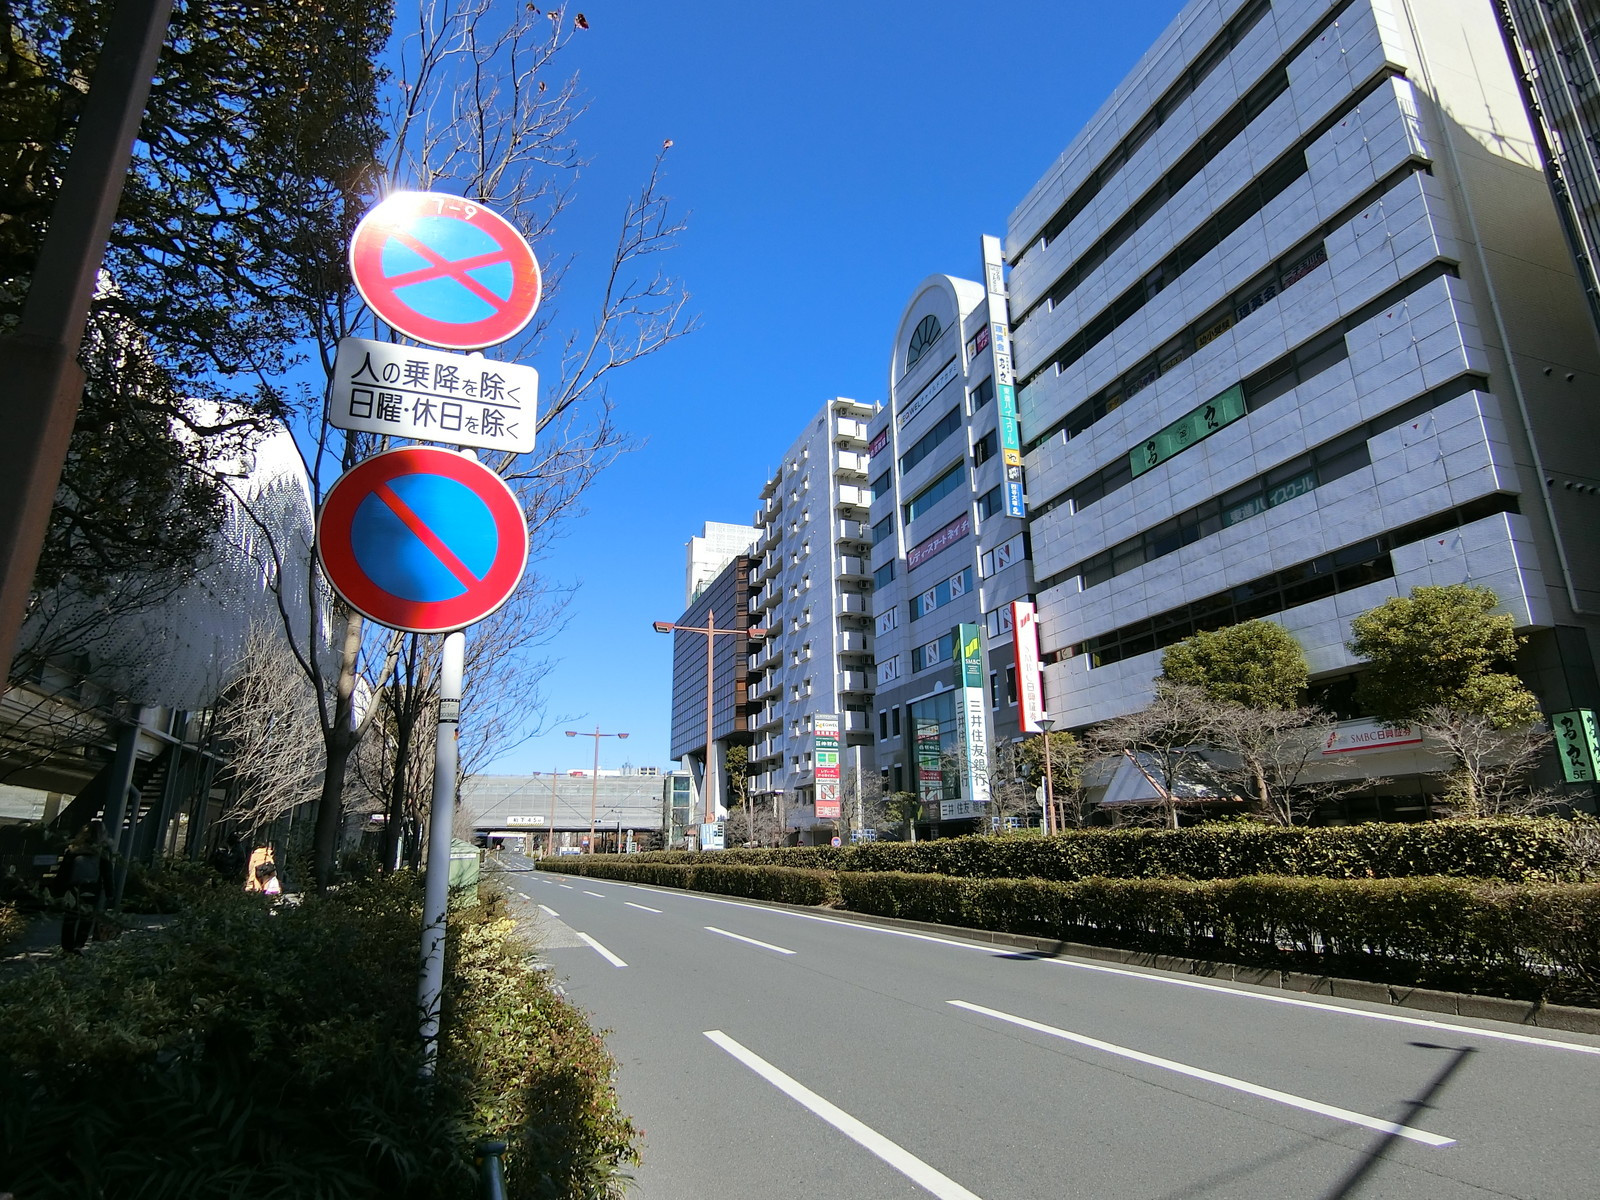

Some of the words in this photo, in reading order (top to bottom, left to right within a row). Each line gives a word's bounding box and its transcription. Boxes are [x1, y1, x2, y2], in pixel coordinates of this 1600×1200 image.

[351, 351, 521, 404] 人の乗降を除く
[349, 388, 519, 440] 日曜・休日を除く
[970, 700, 986, 787] 三井住友銀行
[1573, 769, 1587, 780] 5F
